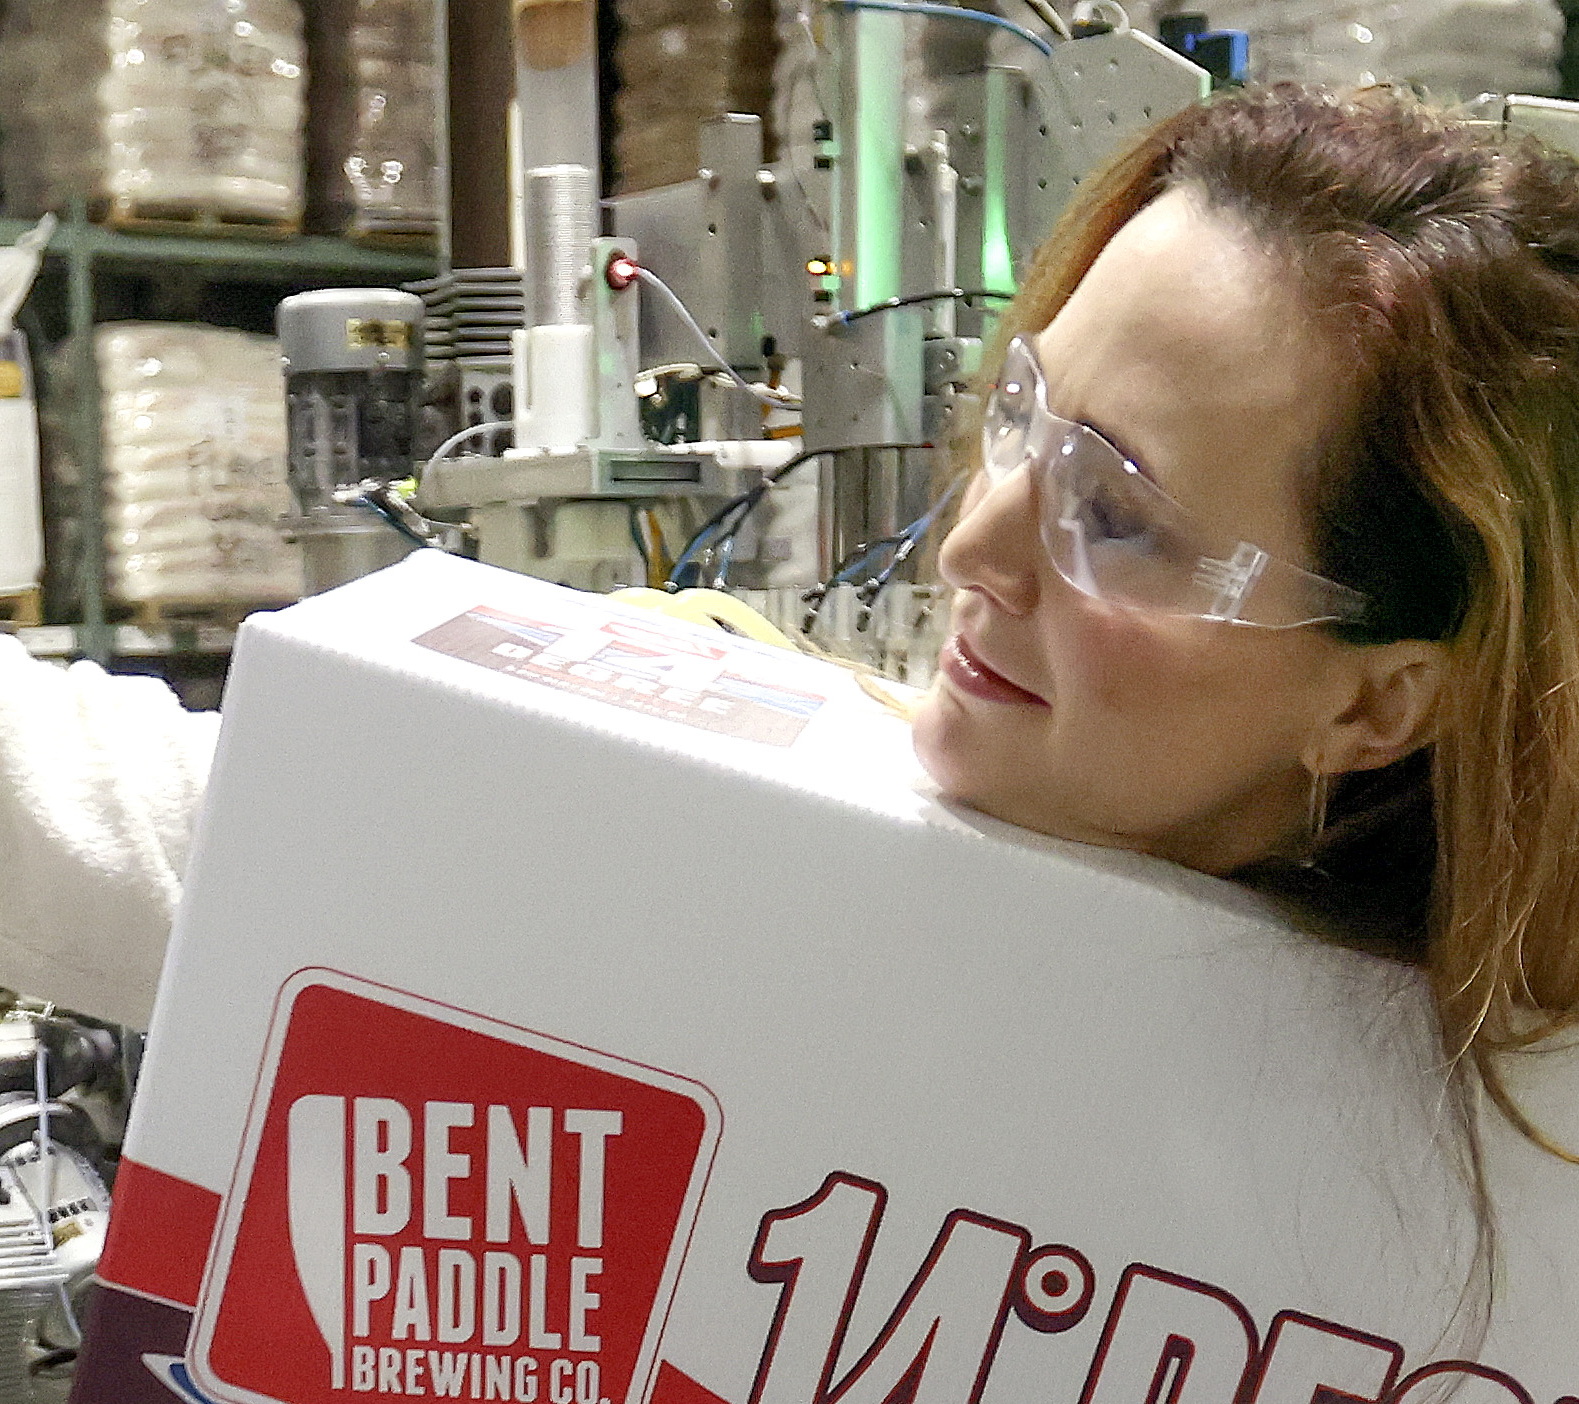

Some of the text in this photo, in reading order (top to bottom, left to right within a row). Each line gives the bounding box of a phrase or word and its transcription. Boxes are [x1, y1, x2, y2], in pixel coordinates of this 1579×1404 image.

[351, 1096, 625, 1250] BENT
[352, 1242, 604, 1354] PADDLE
[351, 1348, 540, 1404] BREWING
